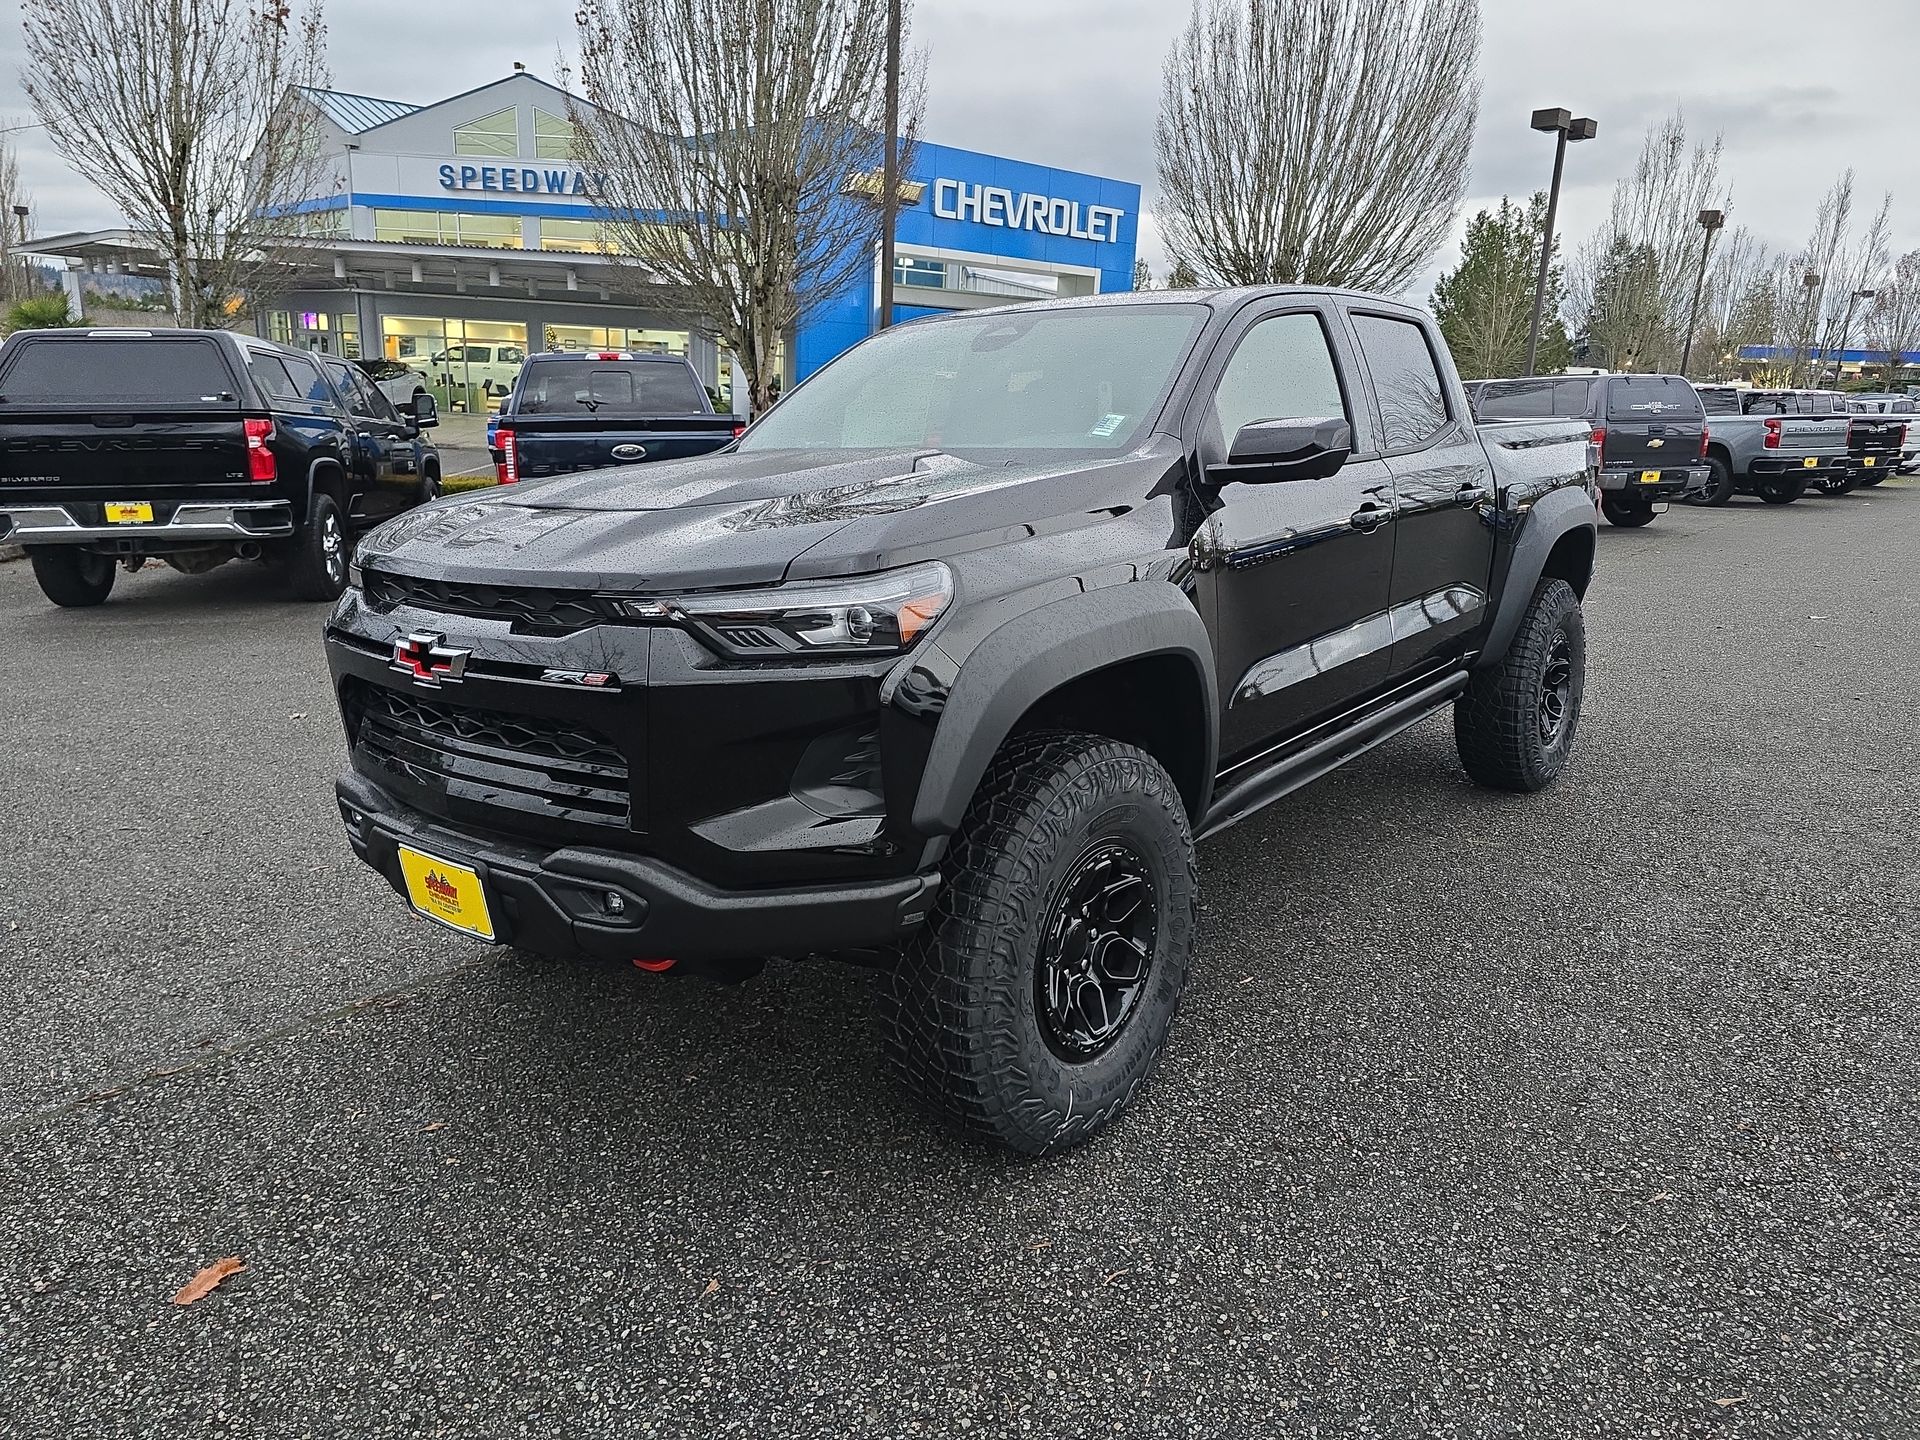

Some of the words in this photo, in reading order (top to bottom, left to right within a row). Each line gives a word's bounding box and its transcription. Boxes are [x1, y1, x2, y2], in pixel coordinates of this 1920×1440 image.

[439, 164, 608, 195] SPEEDWAY
[934, 177, 1125, 243] CHEVROLET
[1786, 425, 1846, 433] CHEVROLET
[541, 669, 609, 685] ZR2
